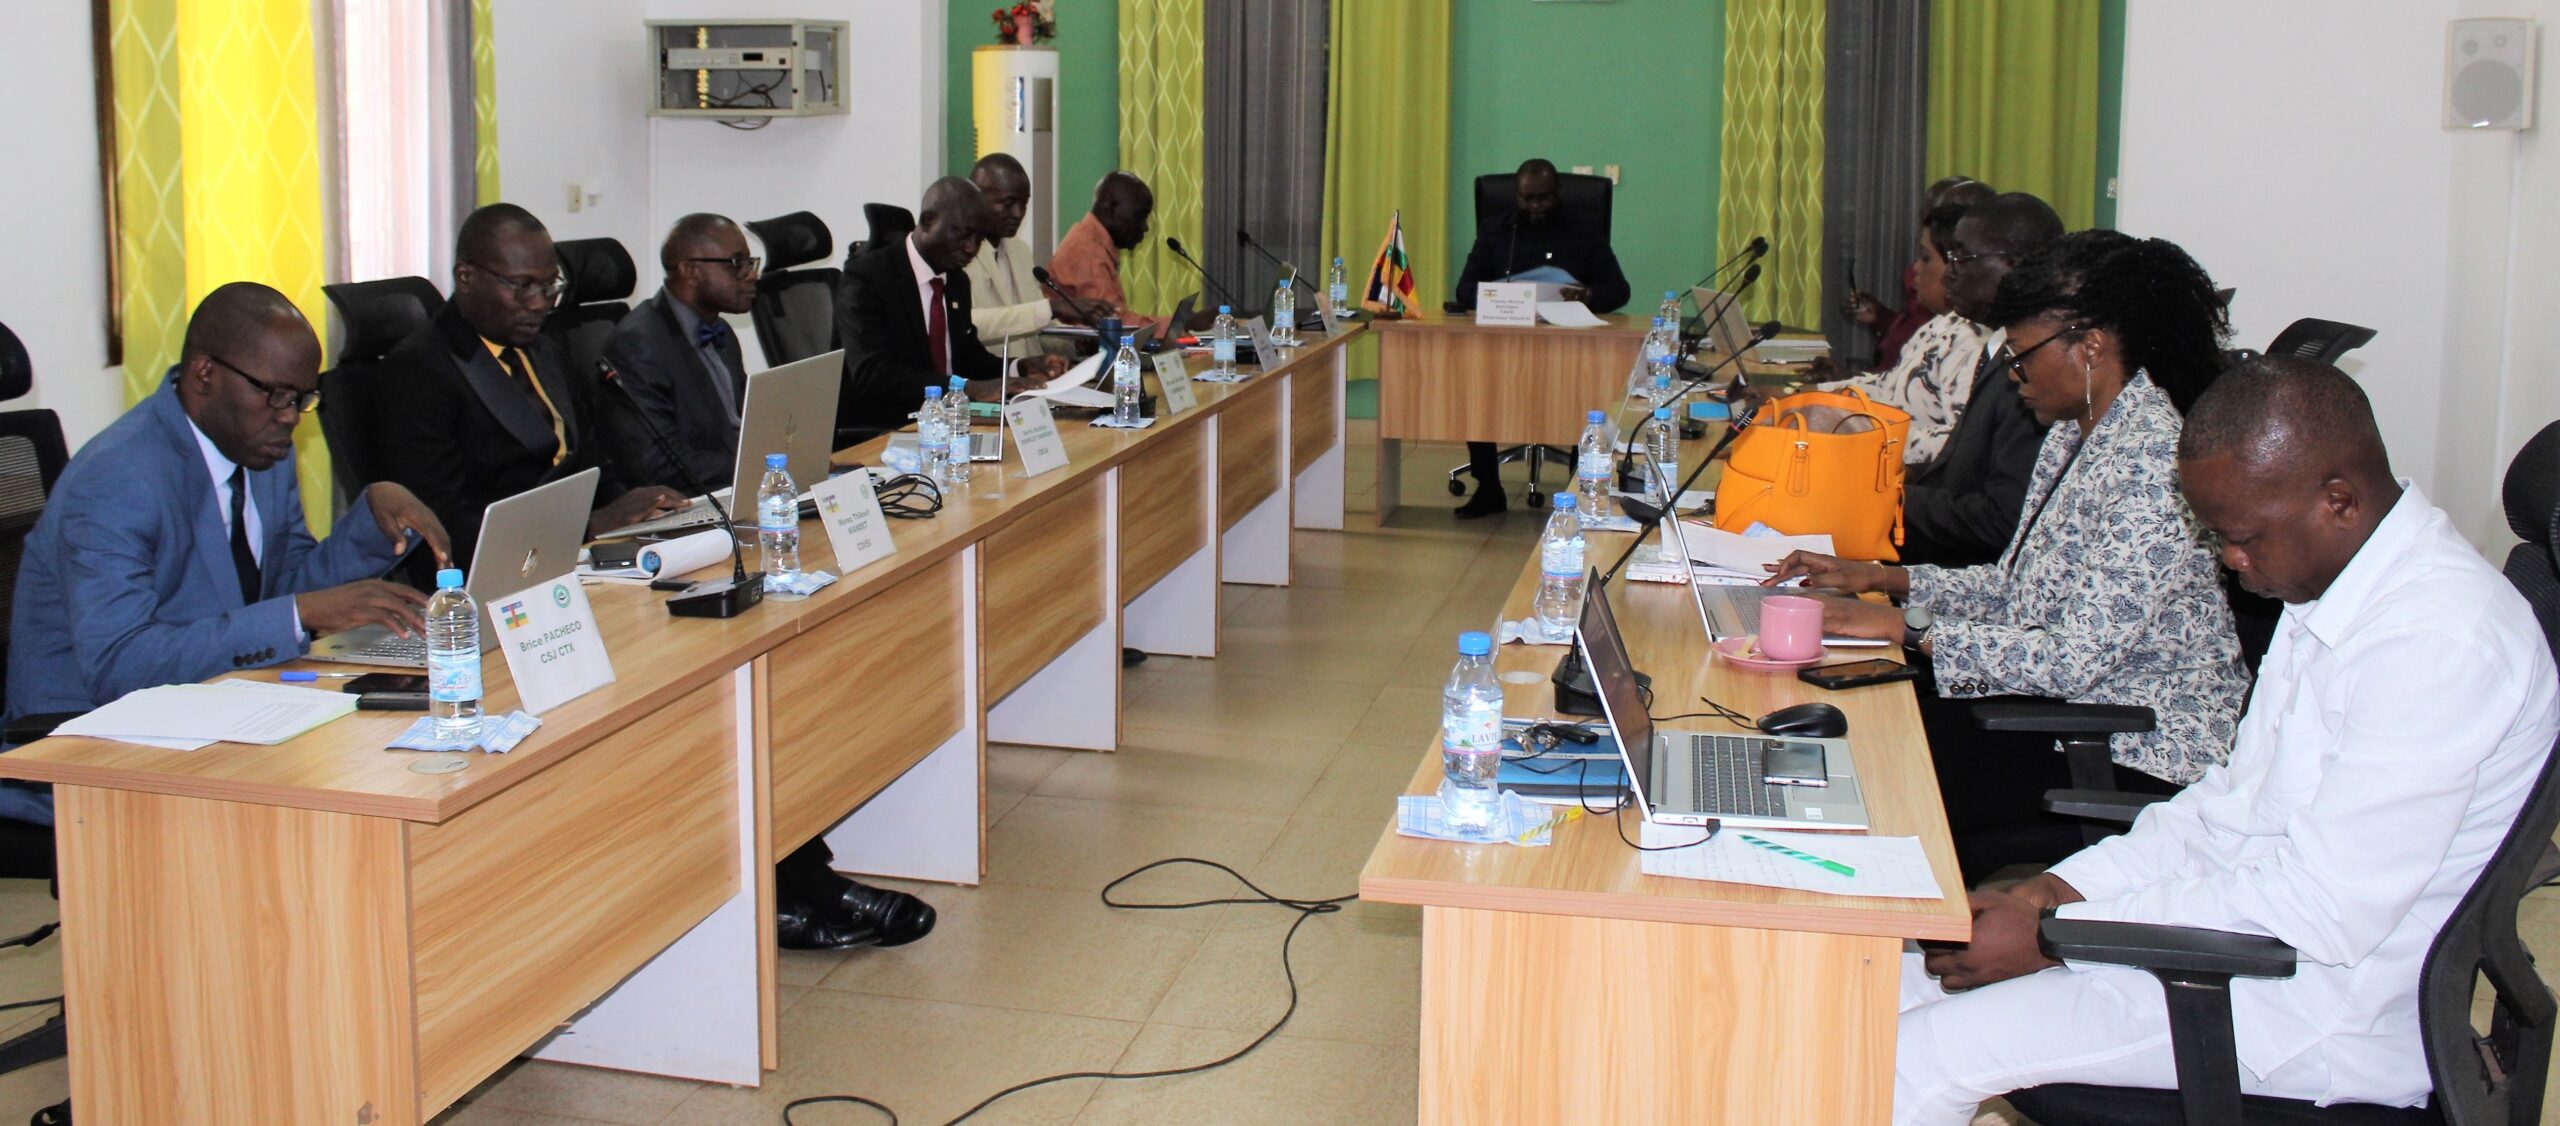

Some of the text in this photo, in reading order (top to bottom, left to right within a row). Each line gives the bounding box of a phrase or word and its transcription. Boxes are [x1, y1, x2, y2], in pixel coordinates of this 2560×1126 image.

[520, 621, 582, 652] Brice PACHECO
[541, 643, 575, 663] CSJ CTX
